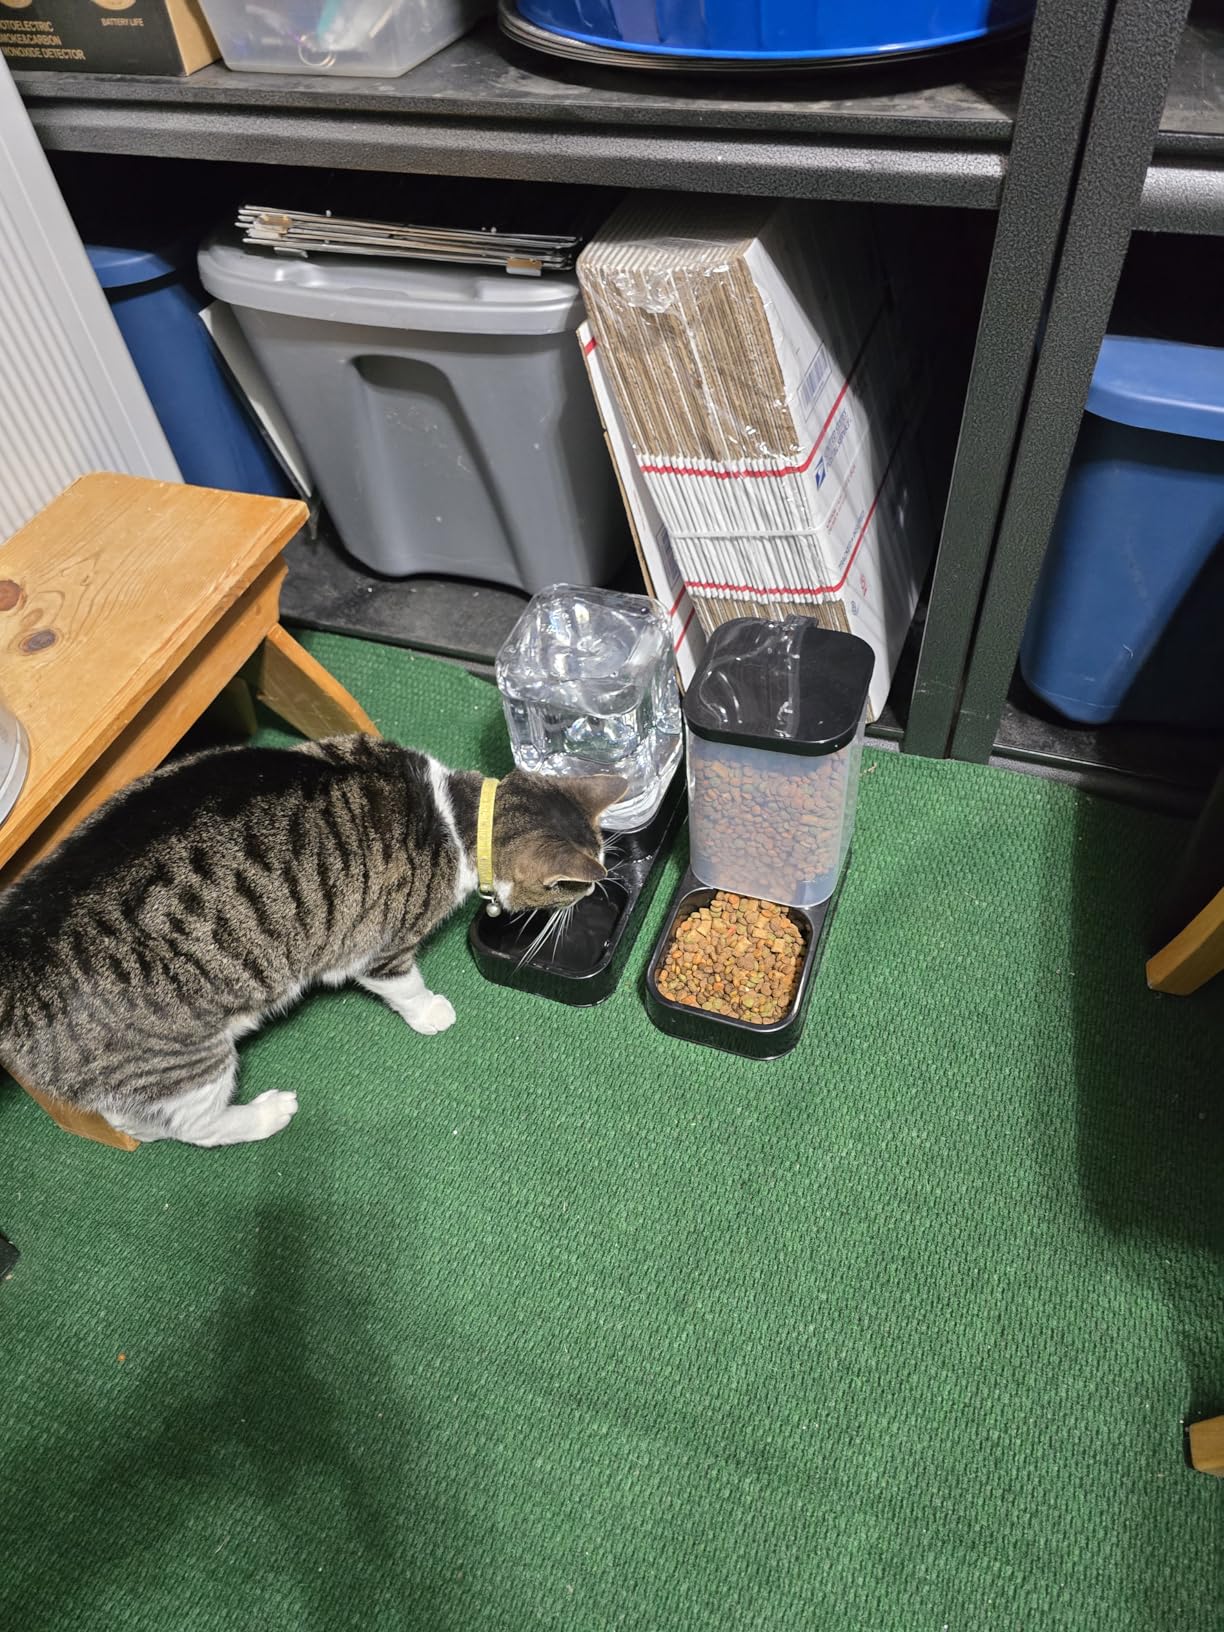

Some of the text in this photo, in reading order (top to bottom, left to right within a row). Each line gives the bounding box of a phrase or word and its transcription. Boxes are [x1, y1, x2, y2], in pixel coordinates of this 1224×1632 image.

[0, 20, 54, 32] OTOELECTRIC
[101, 17, 145, 27] BATTERY LIFE
[41, 48, 86, 61] DETECTOR
